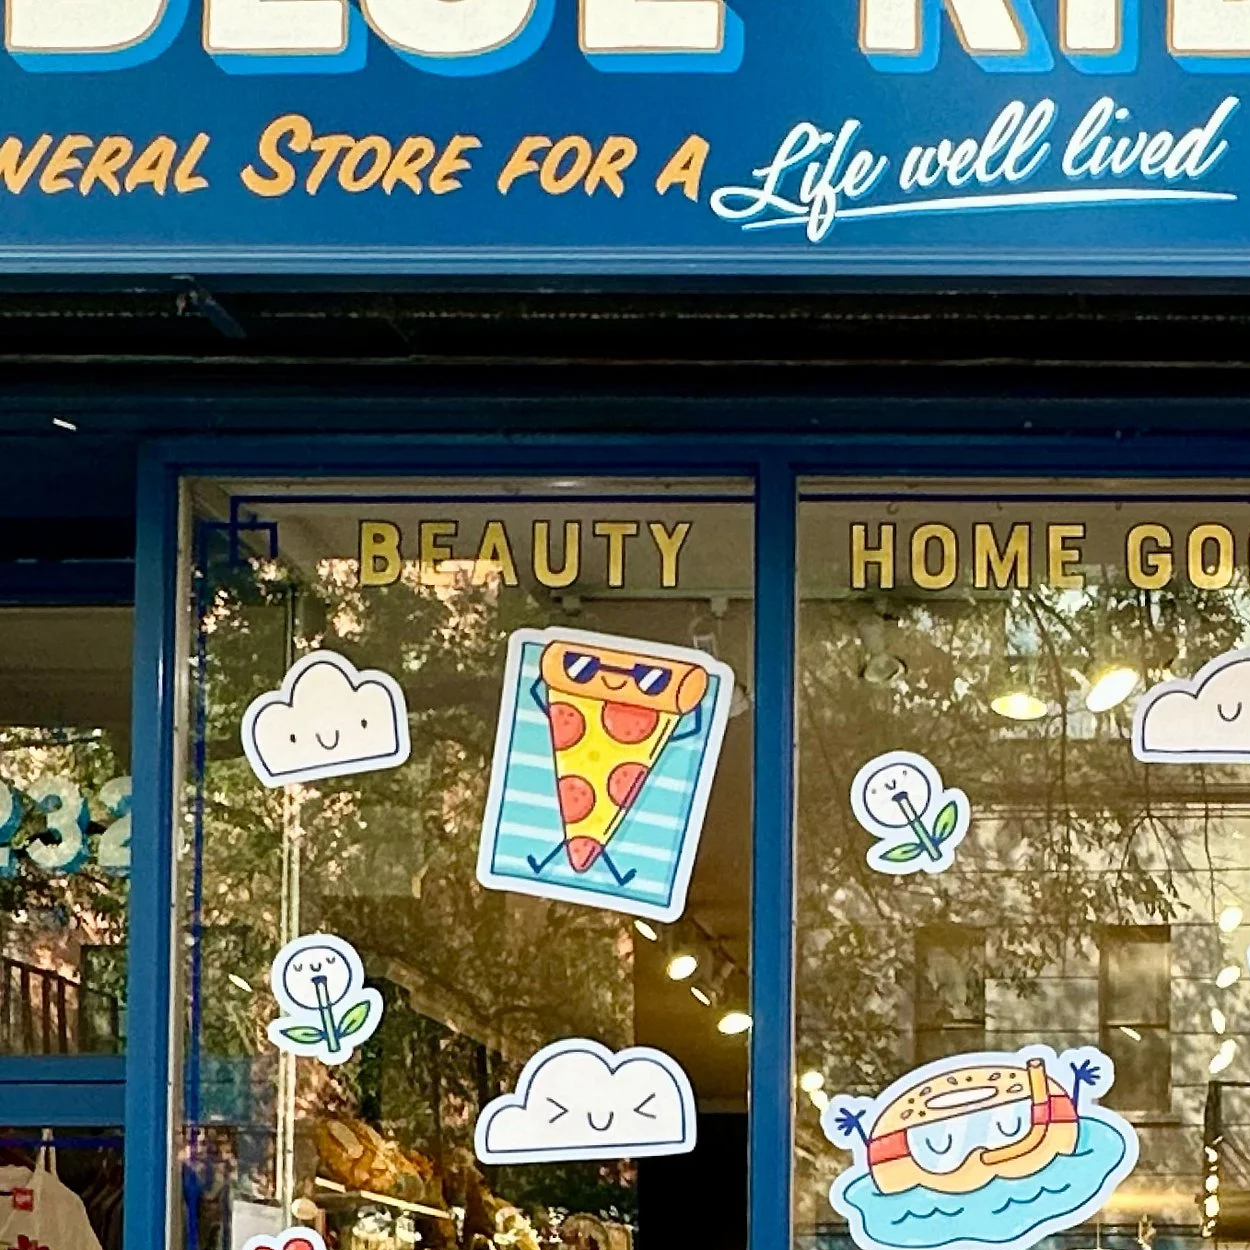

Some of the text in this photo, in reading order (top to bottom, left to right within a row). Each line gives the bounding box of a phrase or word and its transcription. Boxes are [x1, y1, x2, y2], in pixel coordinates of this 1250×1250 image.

[498, 135, 639, 199] FOR
[656, 135, 711, 203] A
[711, 119, 888, 243] Life
[900, 98, 1055, 189] well
[1062, 96, 1240, 182] lived
[357, 519, 693, 589] BEAUTY
[848, 521, 1087, 591] HOME
